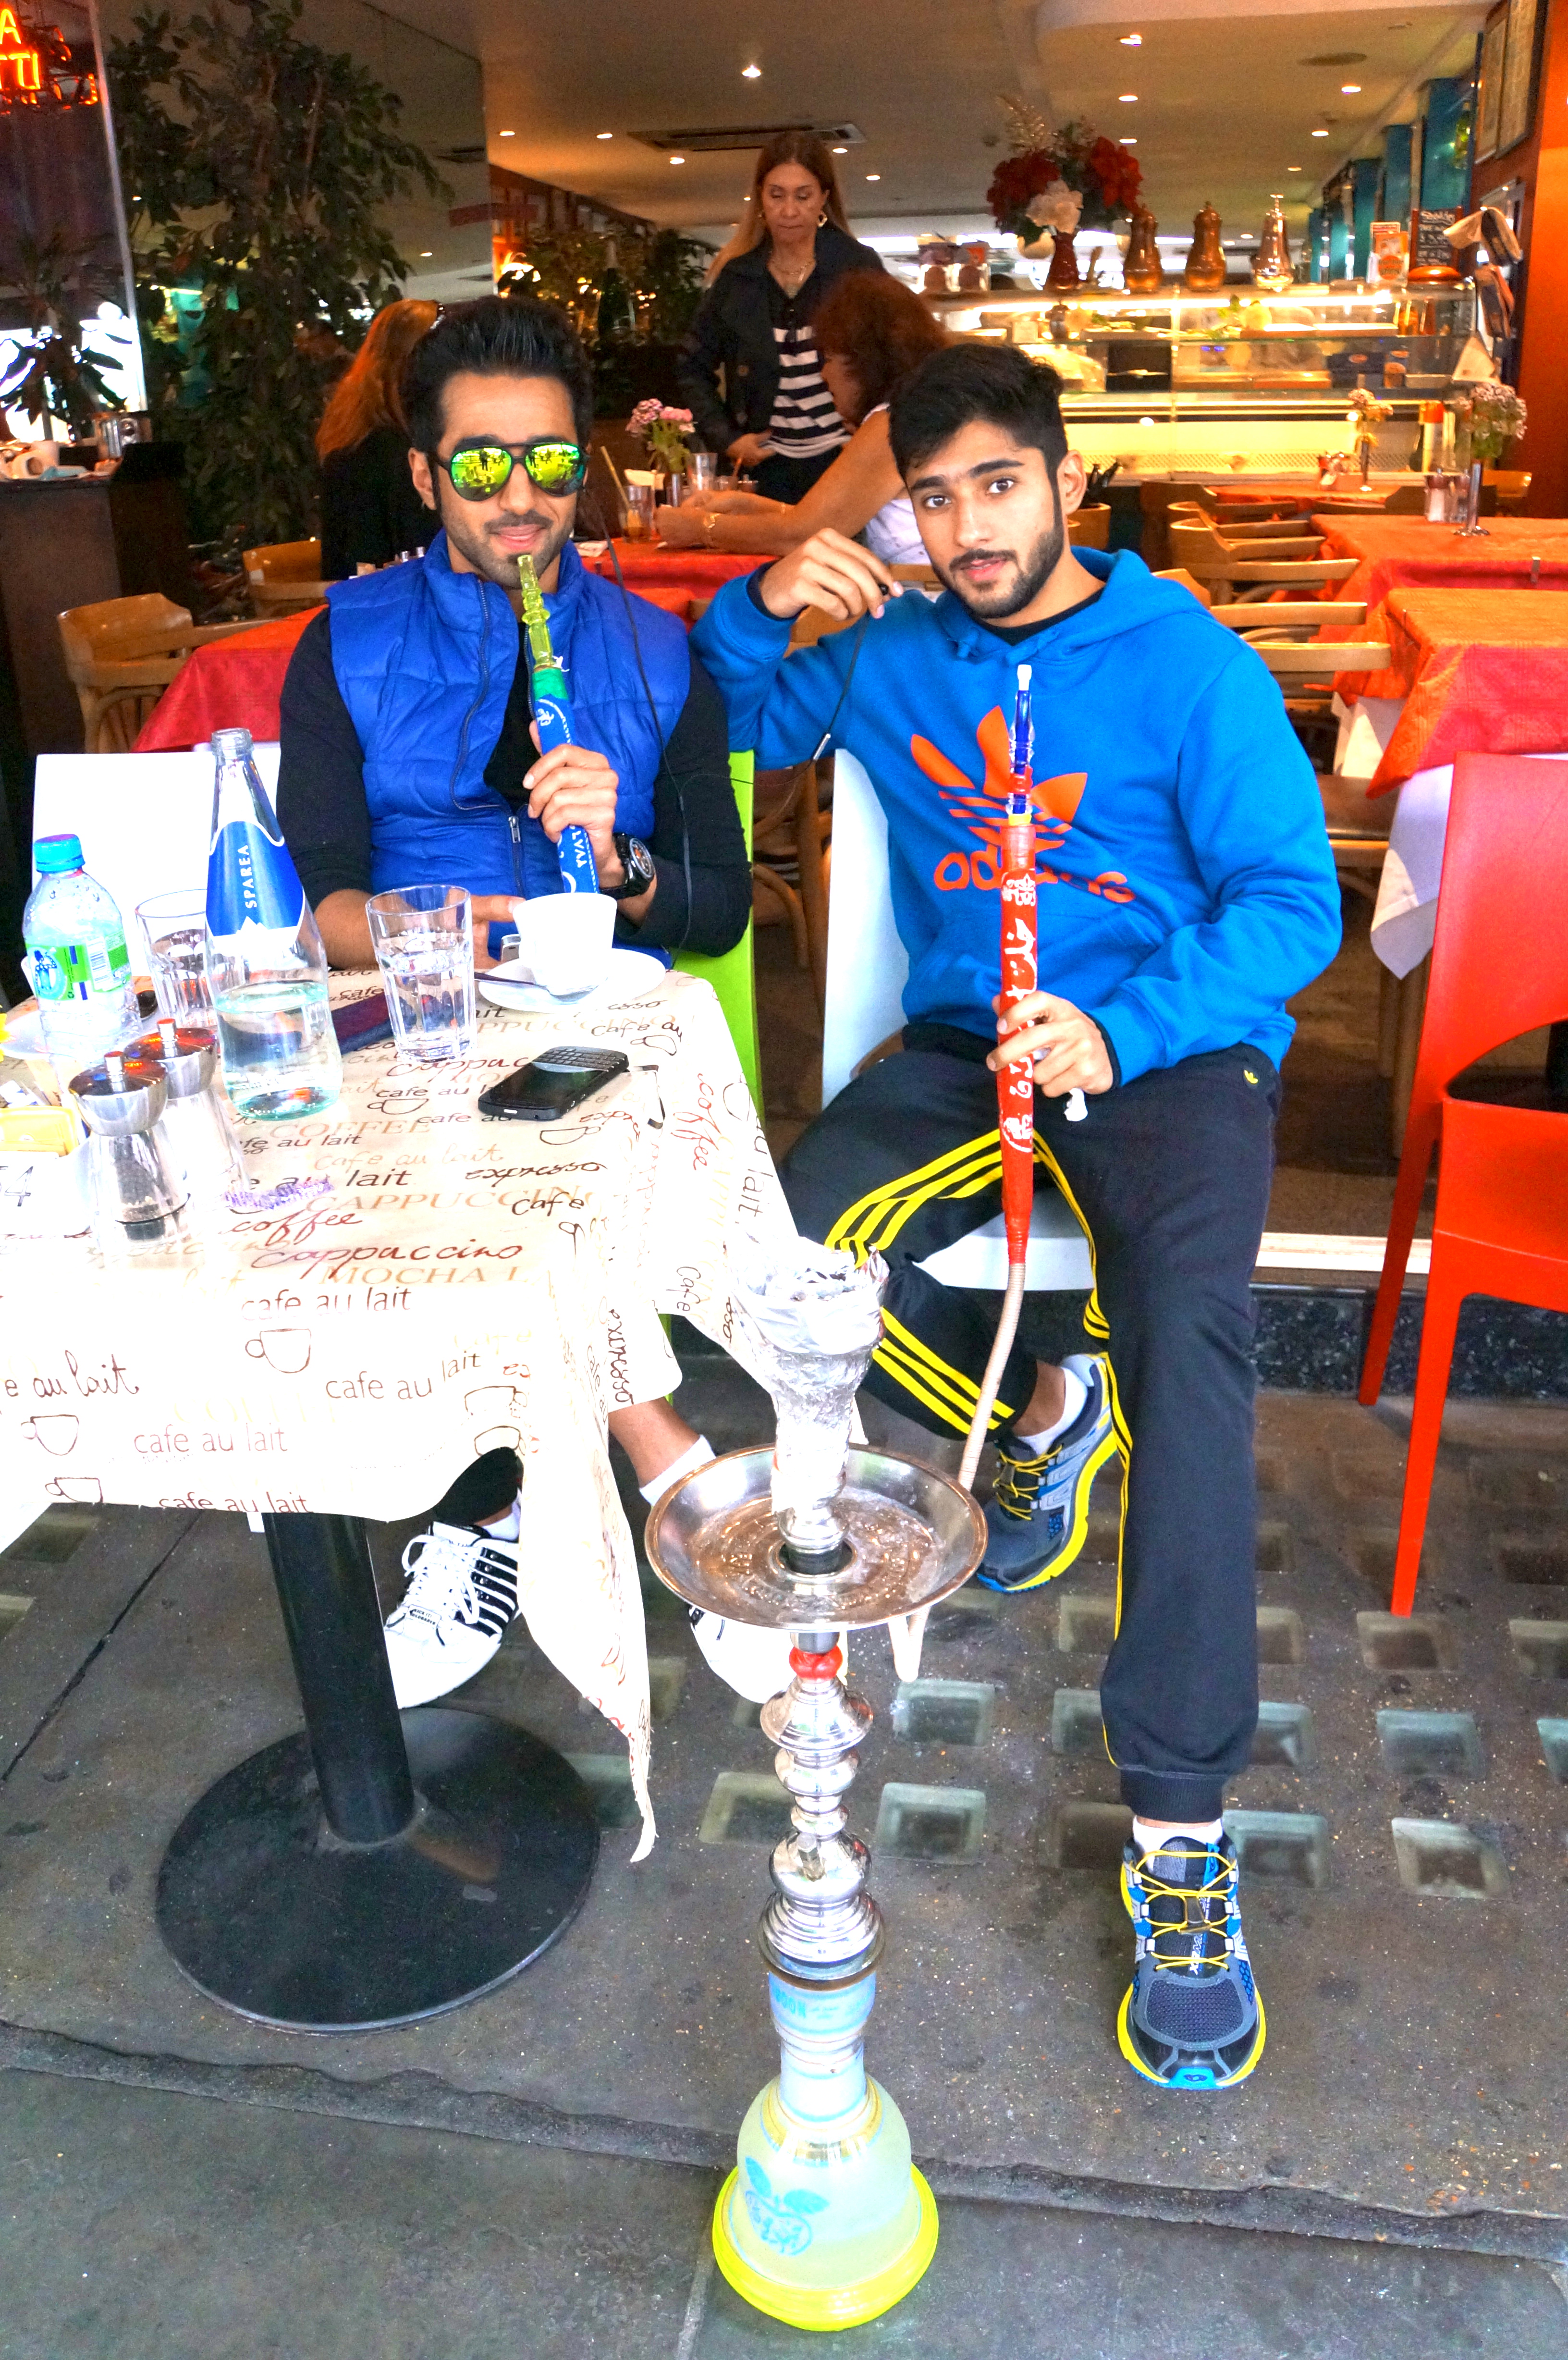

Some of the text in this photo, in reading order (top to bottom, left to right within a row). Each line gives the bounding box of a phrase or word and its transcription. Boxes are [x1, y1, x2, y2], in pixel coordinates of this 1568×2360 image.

[237, 845, 257, 908] SPAREA
[376, 1087, 428, 1097] cafe
[270, 1120, 431, 1137] COFFEE
[417, 1112, 471, 1123] cafe
[277, 1139, 311, 1147] au
[321, 1134, 362, 1146] lait
[396, 1154, 427, 1165] au
[442, 1143, 504, 1164] lait
[346, 1168, 412, 1187] lait
[218, 1208, 363, 1245] coffee
[319, 1266, 486, 1284] MOCHA
[241, 1286, 412, 1321] cafe au lait
[32, 1377, 67, 1398] au
[65, 1350, 139, 1397] lait
[326, 1371, 385, 1399] cafe
[397, 1377, 433, 1399] au
[442, 1351, 481, 1383] lait
[133, 1422, 289, 1454] cafe au lait
[158, 1491, 314, 1513] cafe au lait
